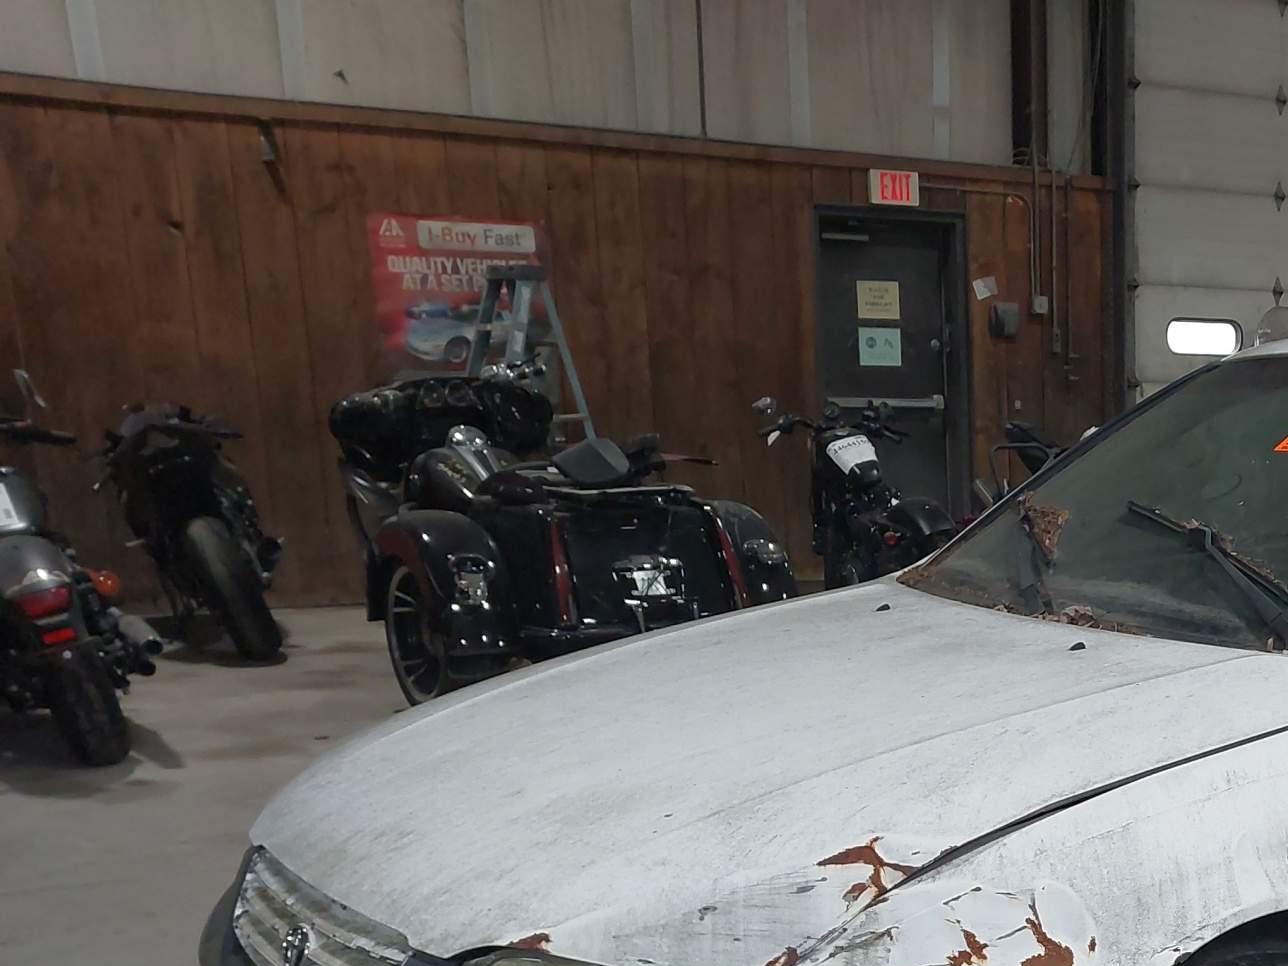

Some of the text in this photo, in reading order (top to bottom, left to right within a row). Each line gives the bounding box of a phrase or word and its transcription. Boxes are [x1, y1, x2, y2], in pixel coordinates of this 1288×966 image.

[880, 172, 912, 202] EXIT
[427, 225, 477, 248] I-Buy
[483, 228, 521, 248] Fast
[387, 255, 454, 275] QUALITY
[402, 274, 423, 290] AT
[426, 274, 439, 290] A
[440, 274, 470, 292] SET
